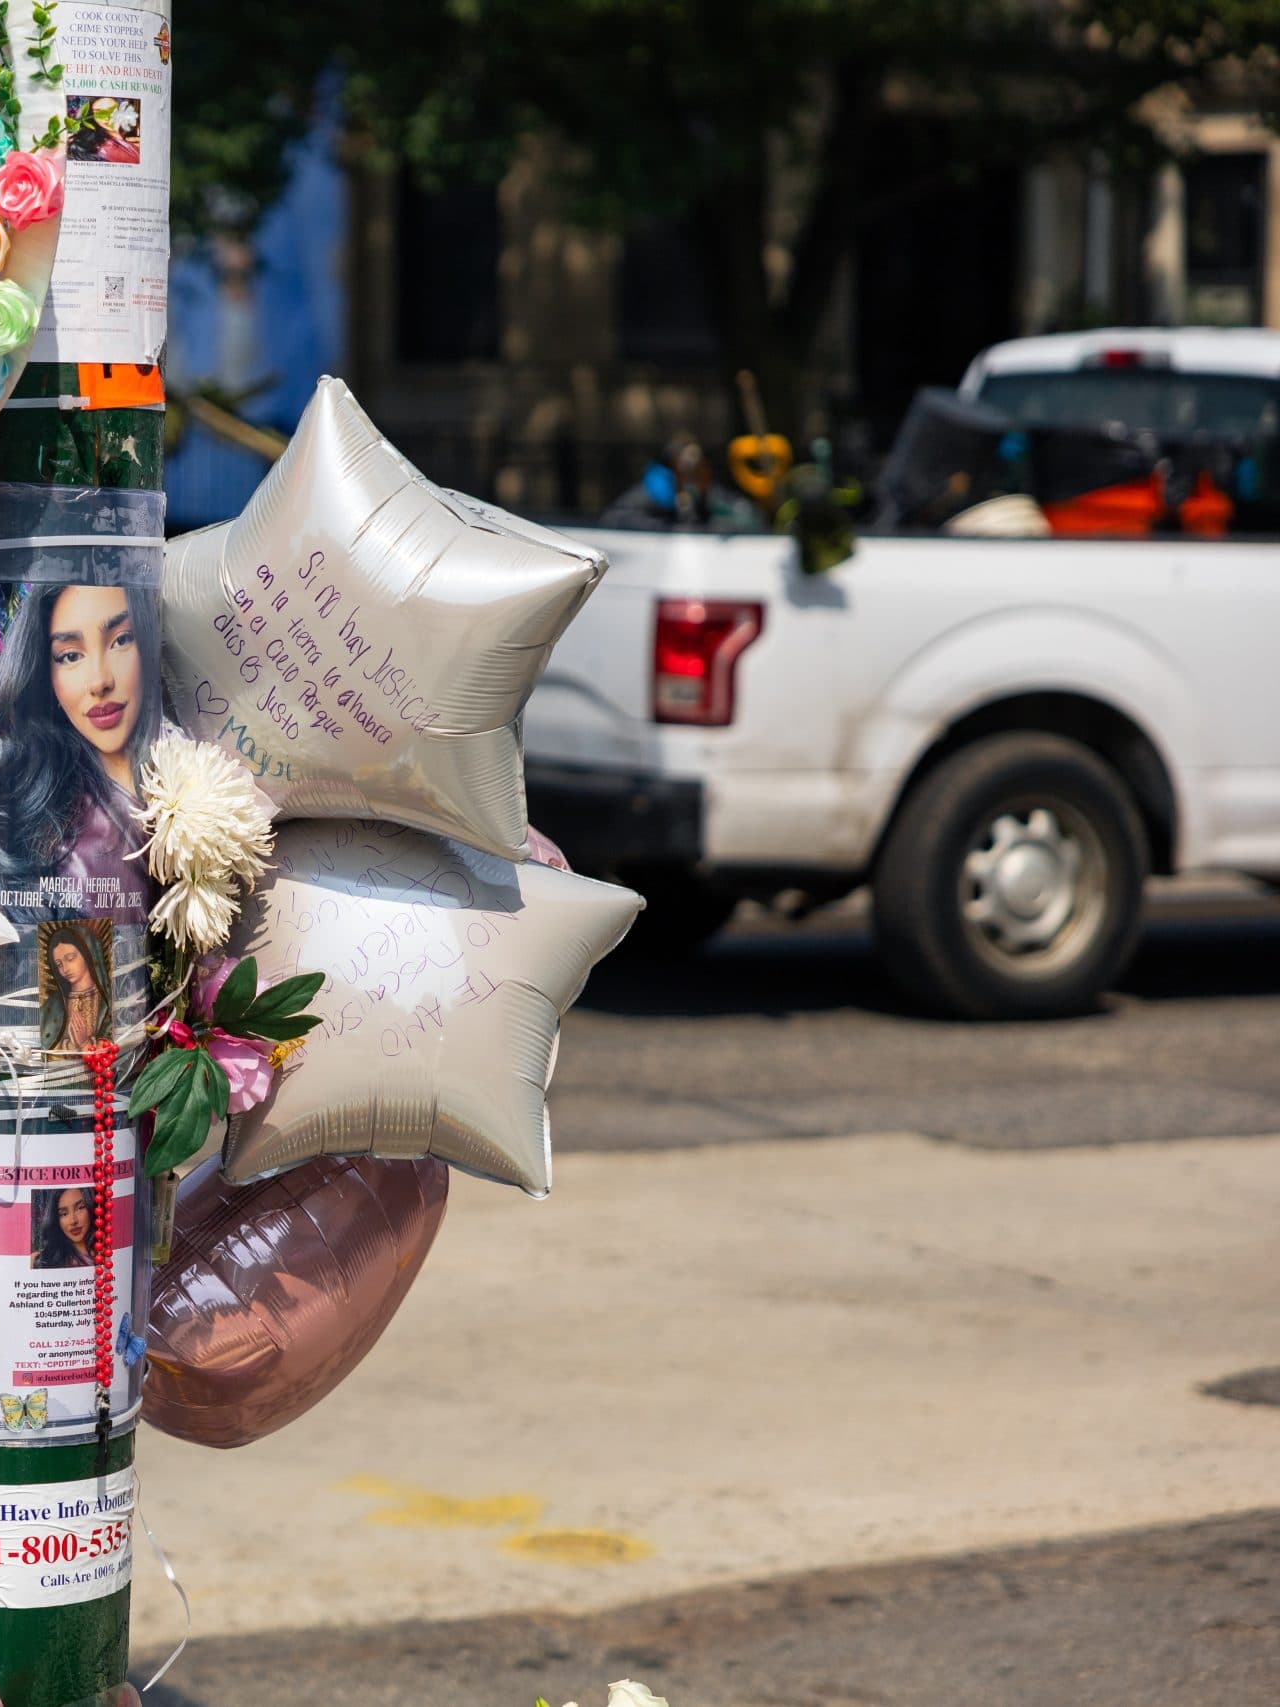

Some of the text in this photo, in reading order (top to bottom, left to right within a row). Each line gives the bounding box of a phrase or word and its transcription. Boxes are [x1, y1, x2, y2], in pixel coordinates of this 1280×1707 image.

[75, 11, 139, 23] COOK COUNTY
[70, 23, 143, 36] CRIME STOPPERS
[62, 36, 148, 50] NEEDS YOUR HELP
[72, 50, 86, 59] TO
[89, 50, 121, 61] SOLVE
[76, 64, 94, 74] HIT
[98, 65, 120, 76] AND
[123, 66, 141, 77] RUN
[100, 79, 128, 90] CASH
[130, 81, 162, 94] REWARD
[233, 589, 254, 613] en
[250, 615, 267, 635] el
[256, 564, 274, 590] en
[271, 590, 289, 613] la
[287, 617, 323, 666] tierra
[323, 666, 341, 690] la
[338, 605, 372, 667] hay
[39, 876, 120, 893] MARCELA HERRERA
[0, 889, 44, 908] OCTUBRE
[48, 892, 56, 909] 7,
[59, 892, 83, 909] 2002
[94, 892, 114, 909] JULY
[127, 891, 142, 907] 2025
[52, 1167, 80, 1180] FOR
[23, 1282, 39, 1290] you
[41, 1280, 61, 1288] have
[62, 1280, 76, 1289] any
[17, 1290, 58, 1299] regarding
[60, 1289, 73, 1297] the
[75, 1288, 85, 1297] hit
[9, 1301, 44, 1309] Ashland
[56, 1298, 91, 1308] Cullerton
[34, 1308, 98, 1318] 10:45PM-11:30P
[35, 1320, 74, 1329] Saturday,
[76, 1318, 91, 1328] July
[29, 1338, 96, 1349] CALL 312-745-45
[15, 1361, 40, 1369] TEXT:
[82, 1358, 90, 1366] to
[0, 1504, 51, 1522] Have
[57, 1500, 89, 1519] Info
[93, 1491, 128, 1513] About
[40, 1573, 70, 1588] Calls
[72, 1571, 91, 1585] Are
[94, 1563, 115, 1580] 100%
